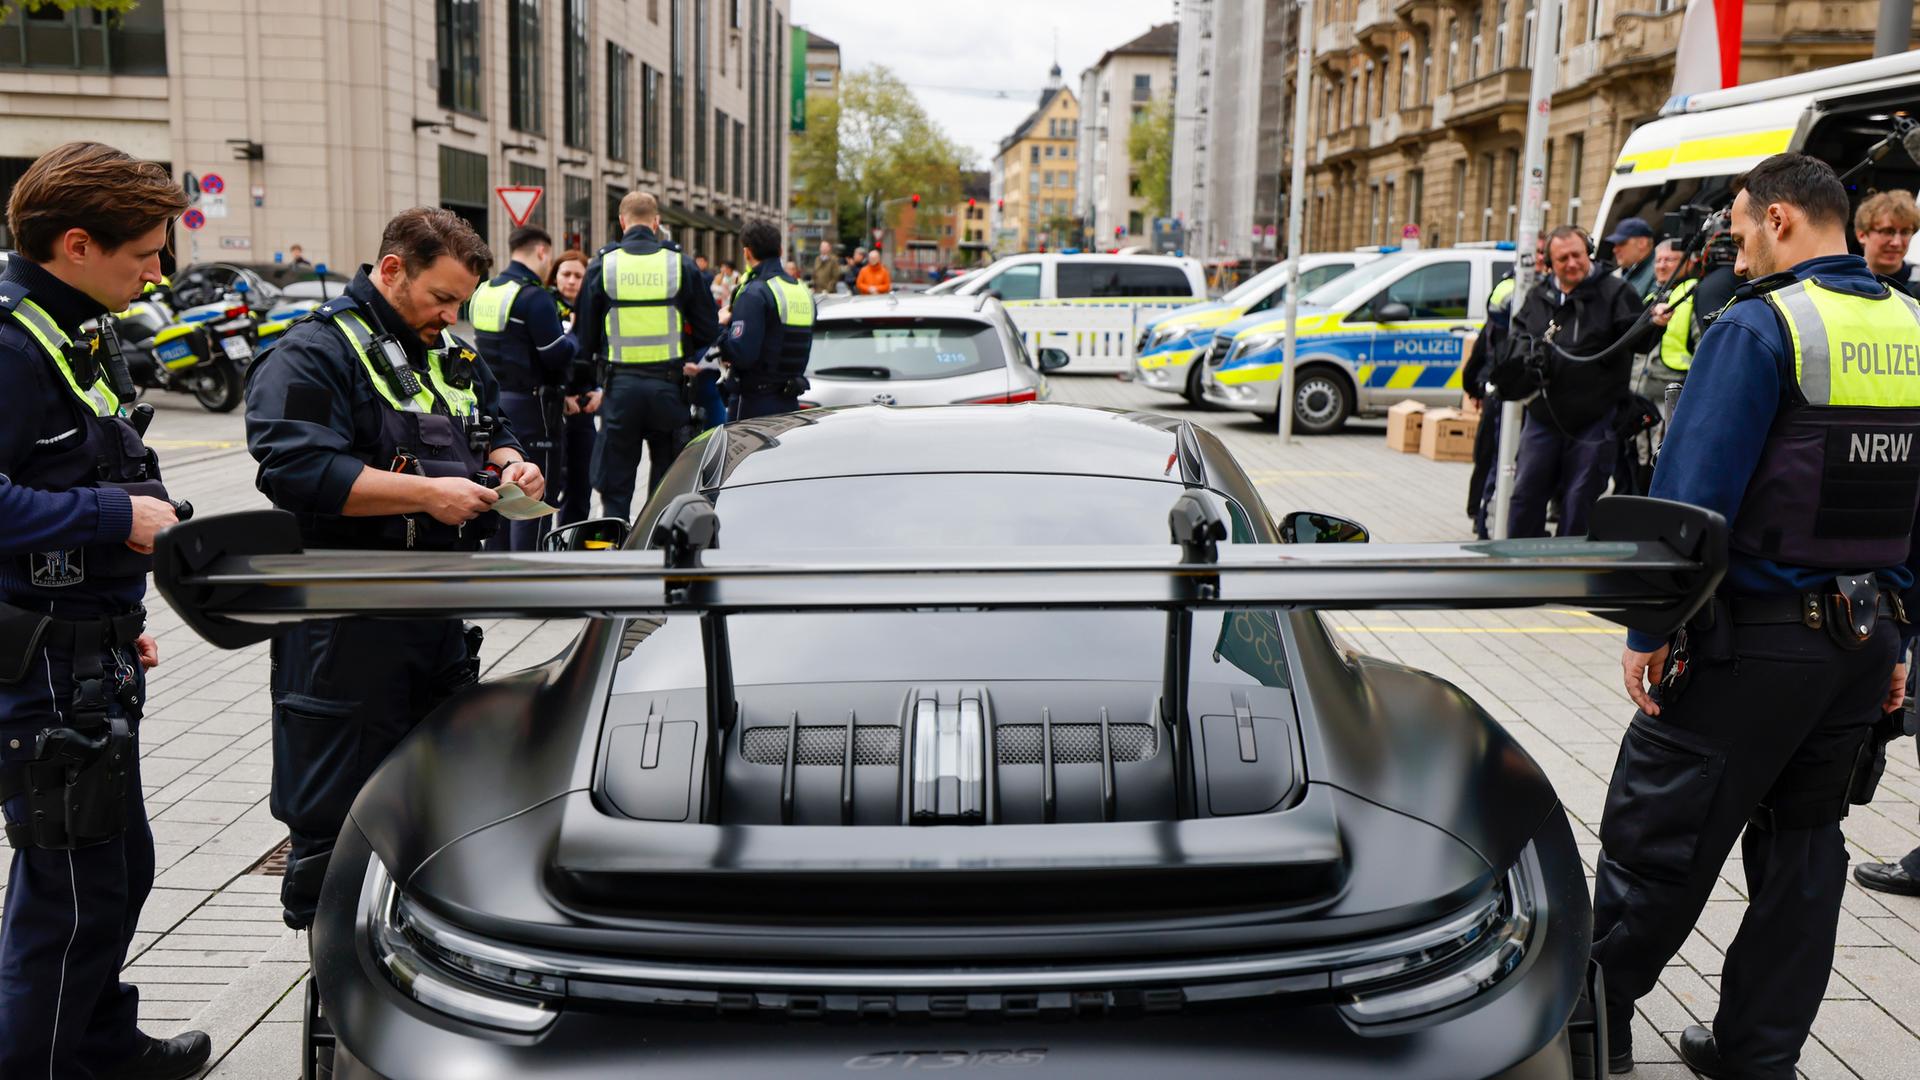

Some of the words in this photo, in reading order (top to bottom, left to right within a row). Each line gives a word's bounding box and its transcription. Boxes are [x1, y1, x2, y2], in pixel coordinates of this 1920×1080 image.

[620, 272, 664, 287] POLIZEI
[1393, 338, 1460, 355] POLIZEI
[1848, 432, 1913, 463] NRW
